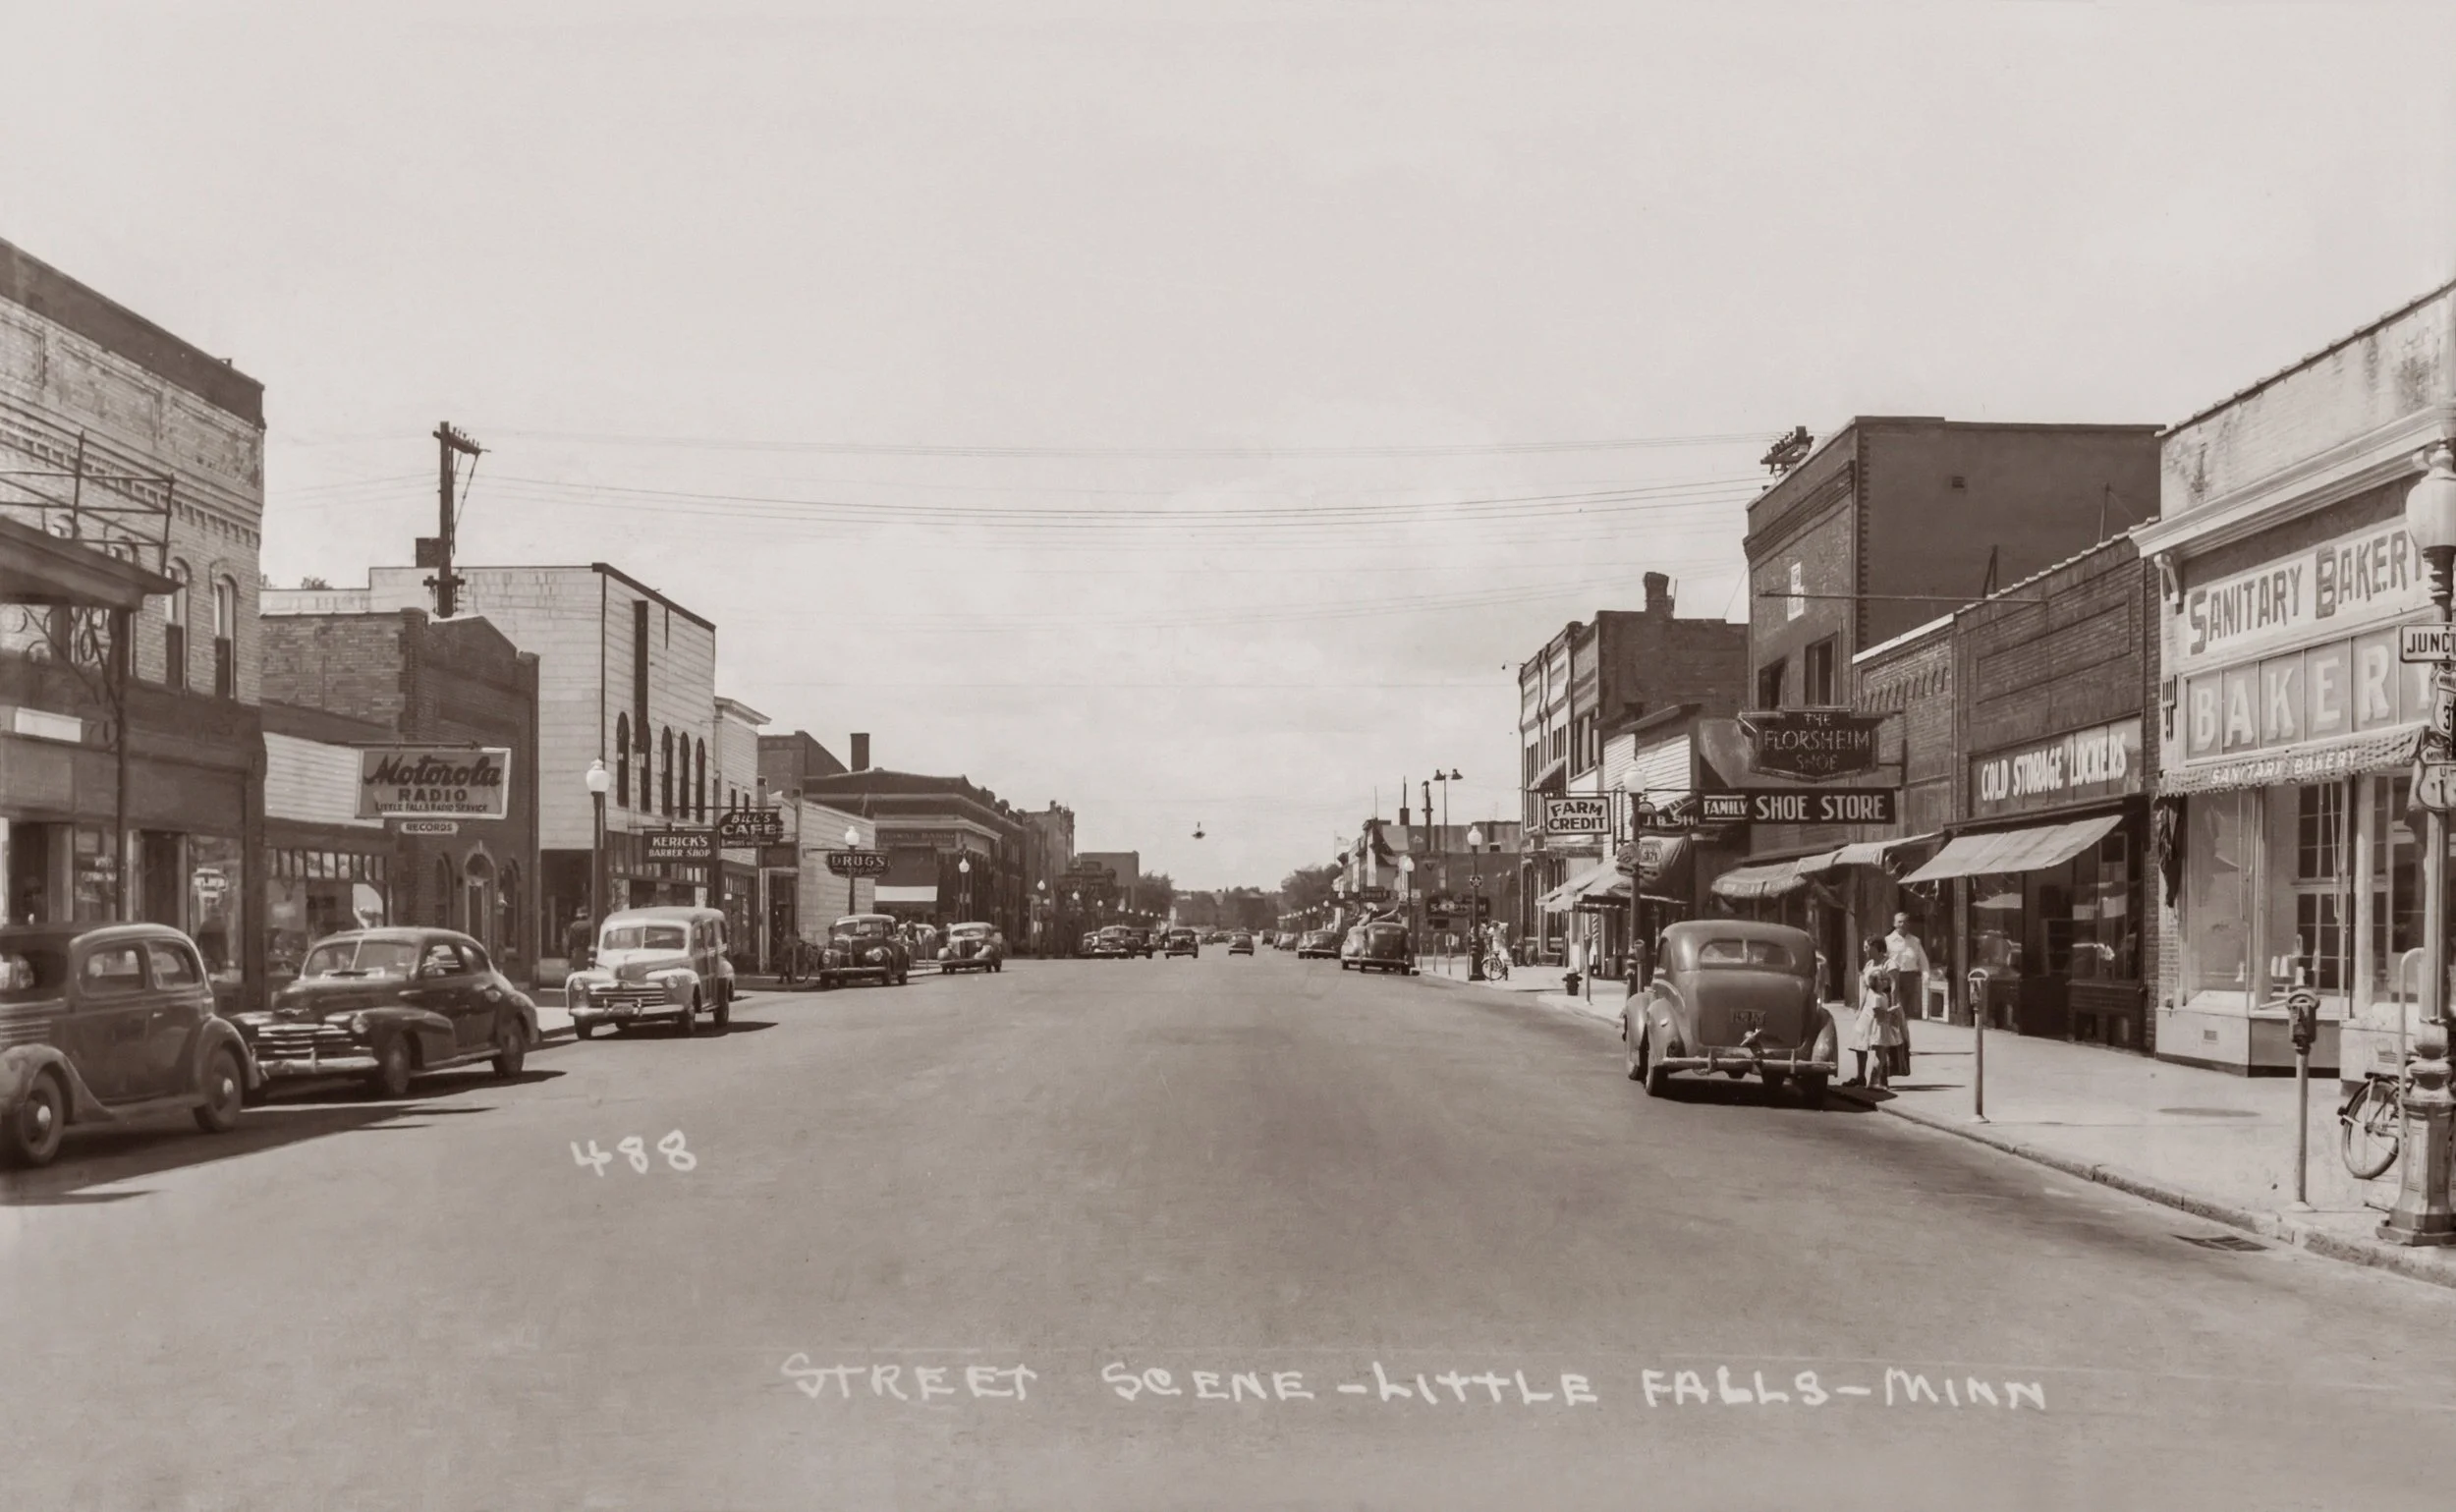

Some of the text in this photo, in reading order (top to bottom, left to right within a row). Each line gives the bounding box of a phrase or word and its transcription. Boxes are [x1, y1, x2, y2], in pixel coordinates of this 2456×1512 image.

[2190, 529, 2423, 655] SANITARY BAKERY
[1804, 712, 1831, 727] THE
[1763, 730, 1870, 751] FLORSHEIM
[1796, 754, 1838, 771] SHOE
[1982, 732, 2127, 801] COLD STORAGE LOCKERS
[2210, 750, 2358, 786] SANITARY BAKERY
[363, 755, 501, 786] Motorola
[398, 789, 468, 802] RADIO
[455, 804, 488, 812] SERVICE
[1703, 795, 1887, 820] FAMILY SHOE STORE
[731, 813, 771, 823] BILL'S
[1548, 802, 1606, 830] FARM CREDIT
[406, 823, 453, 833] RECORDS
[721, 824, 778, 835] CAFE
[652, 835, 708, 847] KERICK'S
[648, 849, 711, 858] BARBER SHOP
[831, 855, 885, 867] DRUGS
